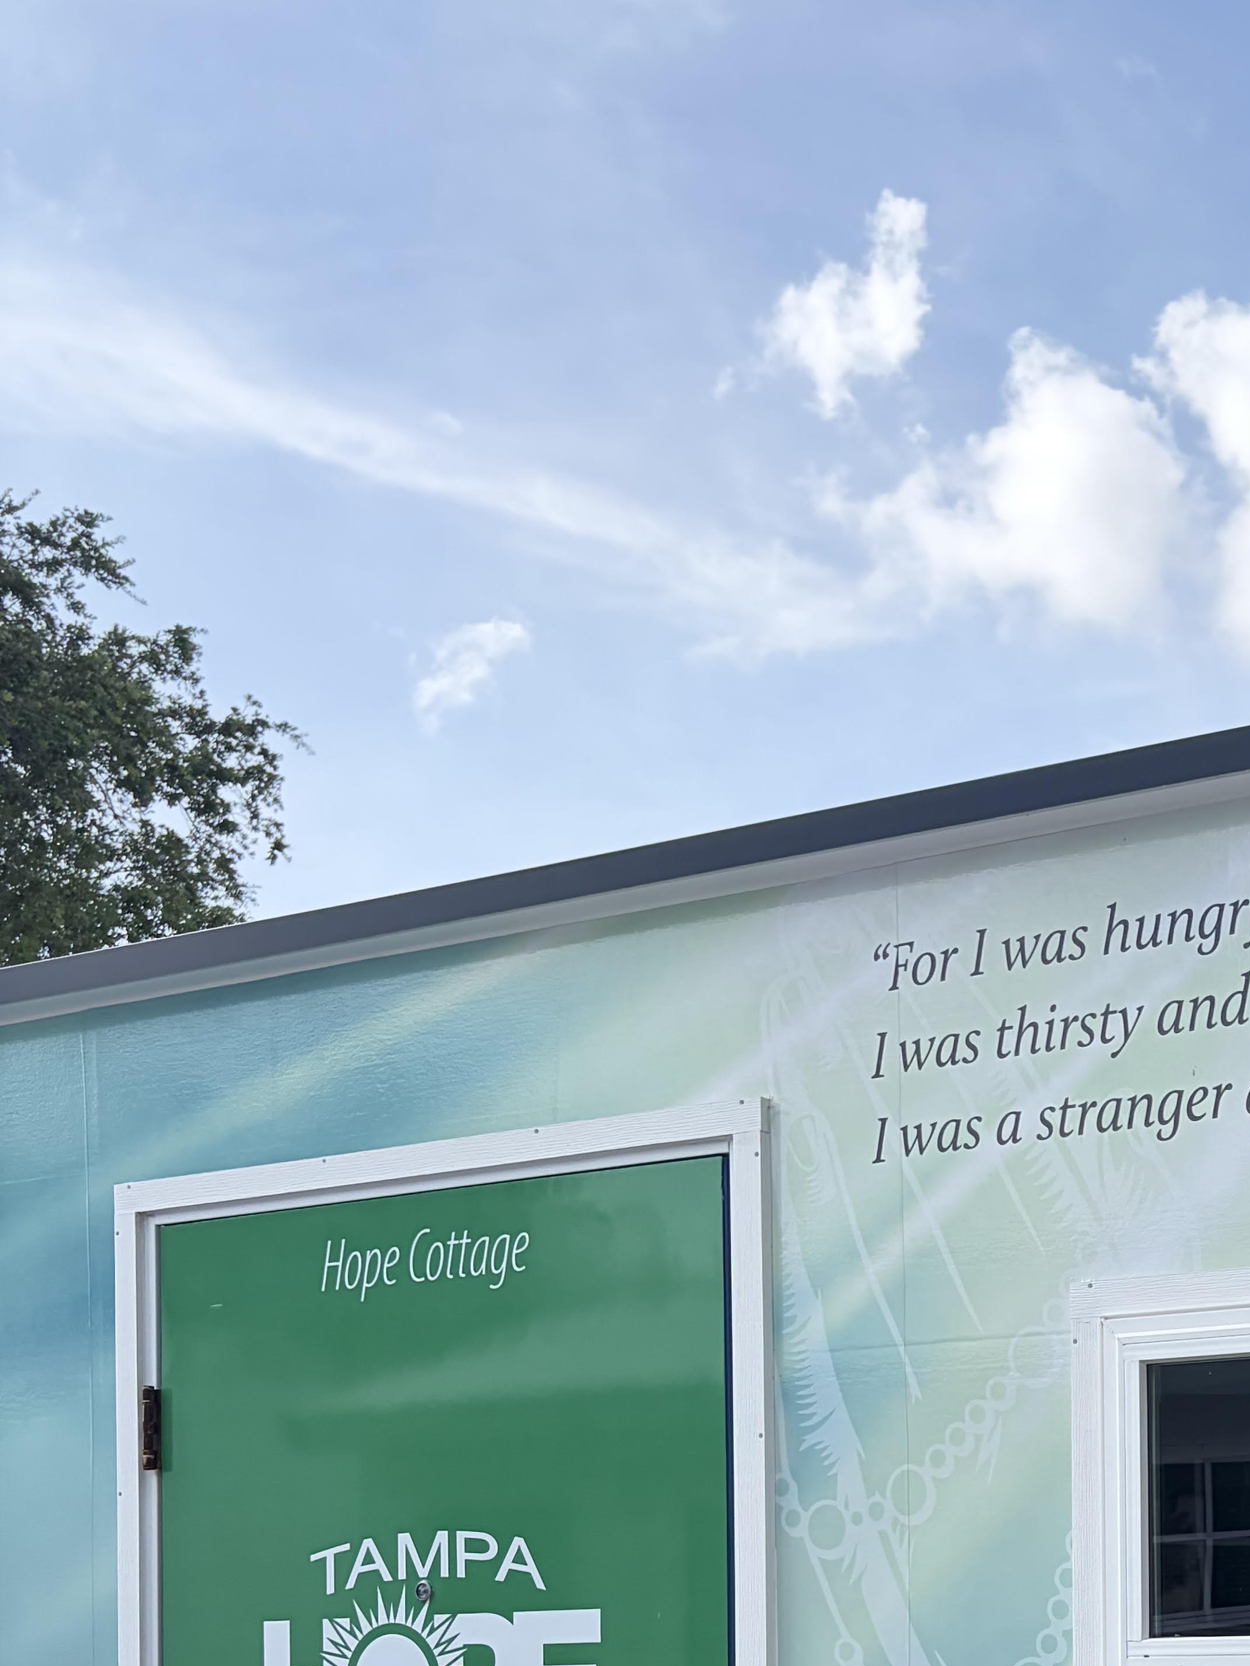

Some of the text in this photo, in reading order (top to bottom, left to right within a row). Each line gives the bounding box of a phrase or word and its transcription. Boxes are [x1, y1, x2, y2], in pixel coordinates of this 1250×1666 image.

[873, 941, 959, 992] “For
[969, 928, 988, 977] I
[1001, 925, 1089, 972] was
[870, 1031, 888, 1080] I
[898, 1029, 982, 1073] was
[996, 1002, 1145, 1060] thirsty
[871, 1117, 889, 1165] I
[899, 1115, 983, 1158] was
[996, 1110, 1023, 1146] a
[1035, 1082, 1234, 1142] stranger
[320, 1228, 530, 1303] Hope Cottage
[309, 1529, 547, 1596] TAMPA
